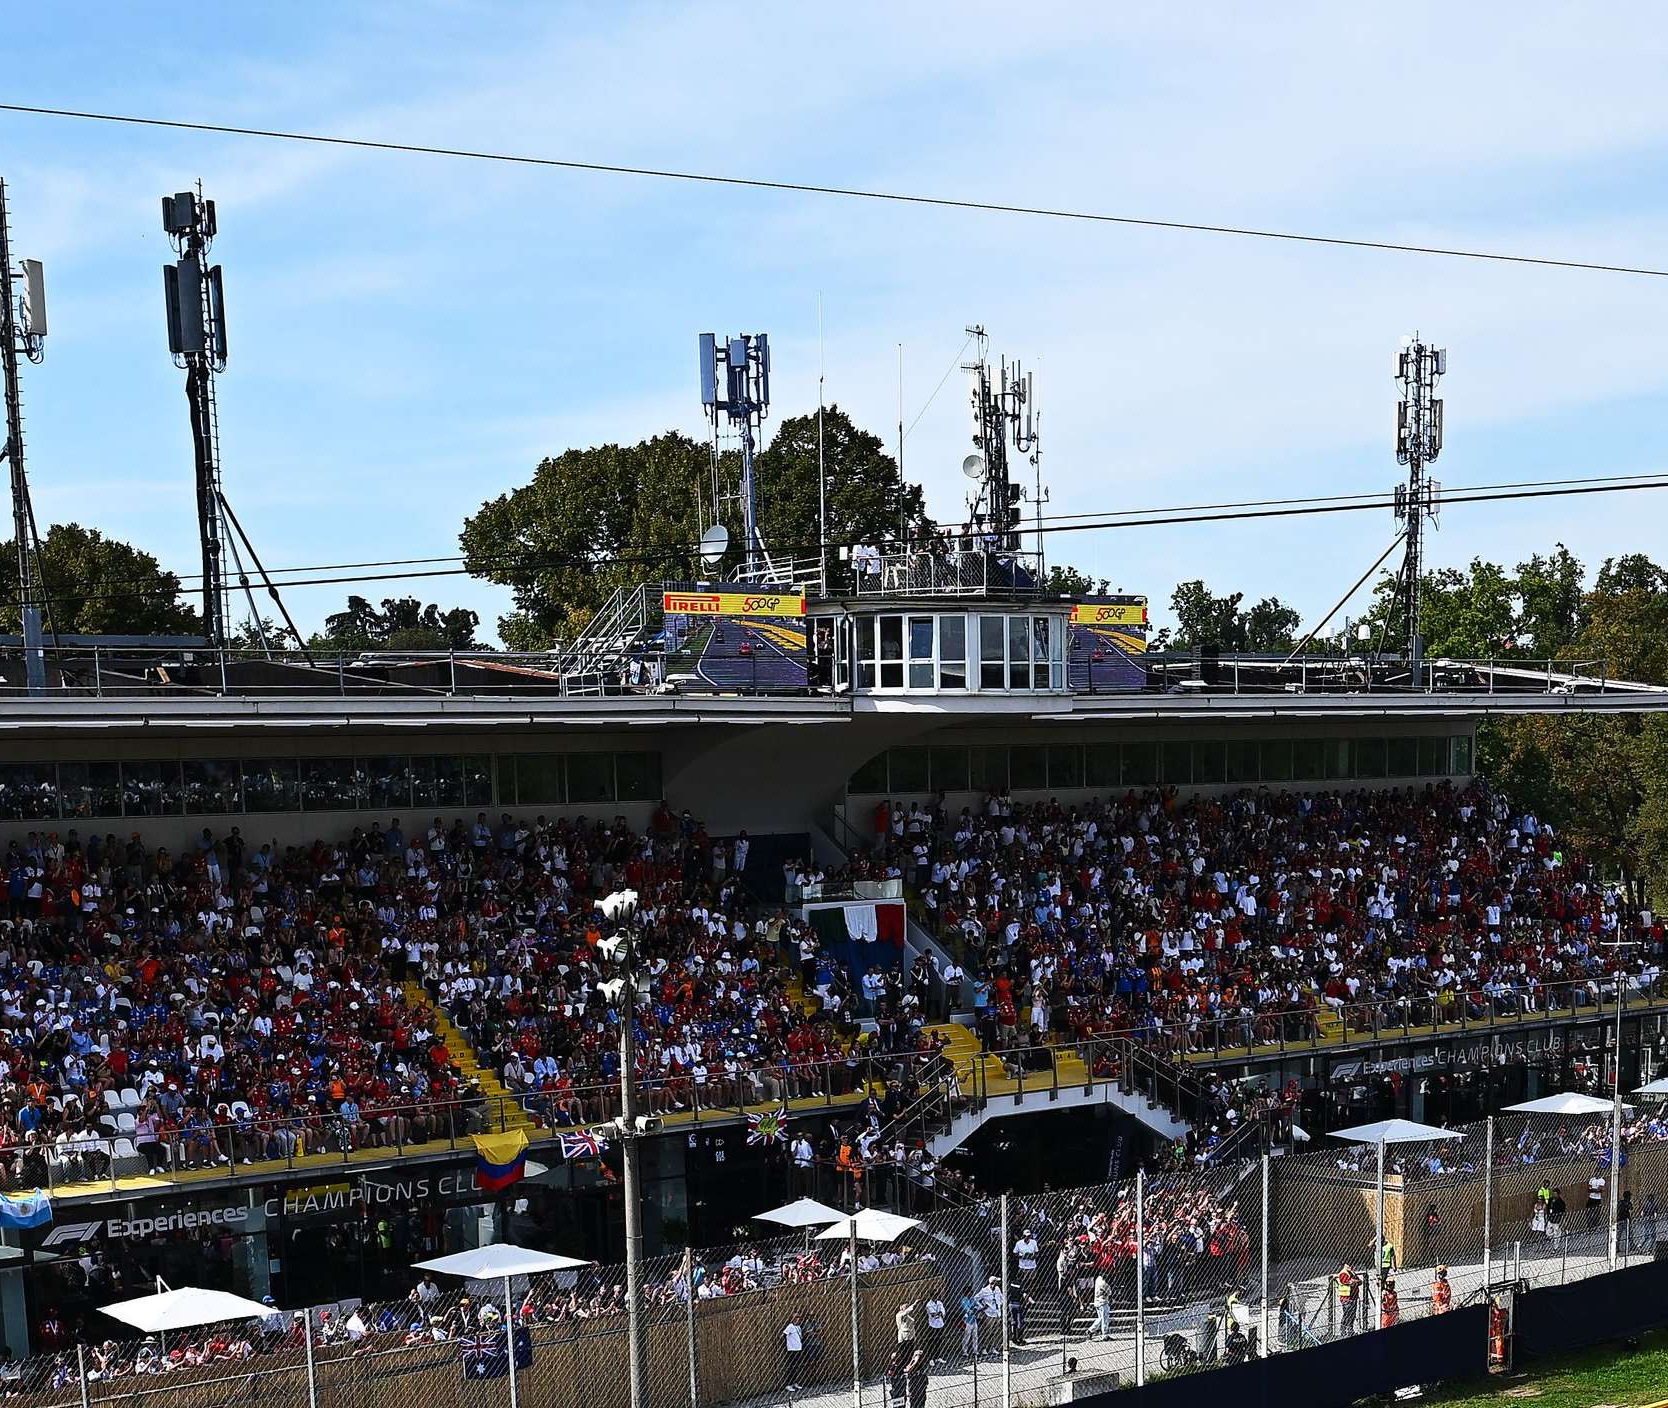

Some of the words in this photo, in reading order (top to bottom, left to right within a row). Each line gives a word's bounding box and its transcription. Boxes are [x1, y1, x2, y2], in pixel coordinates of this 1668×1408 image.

[664, 594, 720, 612] PIRELLI
[1363, 1054, 1435, 1076] Experiences
[1437, 1041, 1523, 1065] CHAMPIONS
[1526, 1036, 1562, 1053] CLUB
[107, 1206, 249, 1239] Experiences
[264, 1180, 430, 1218] CHAMPIONS
